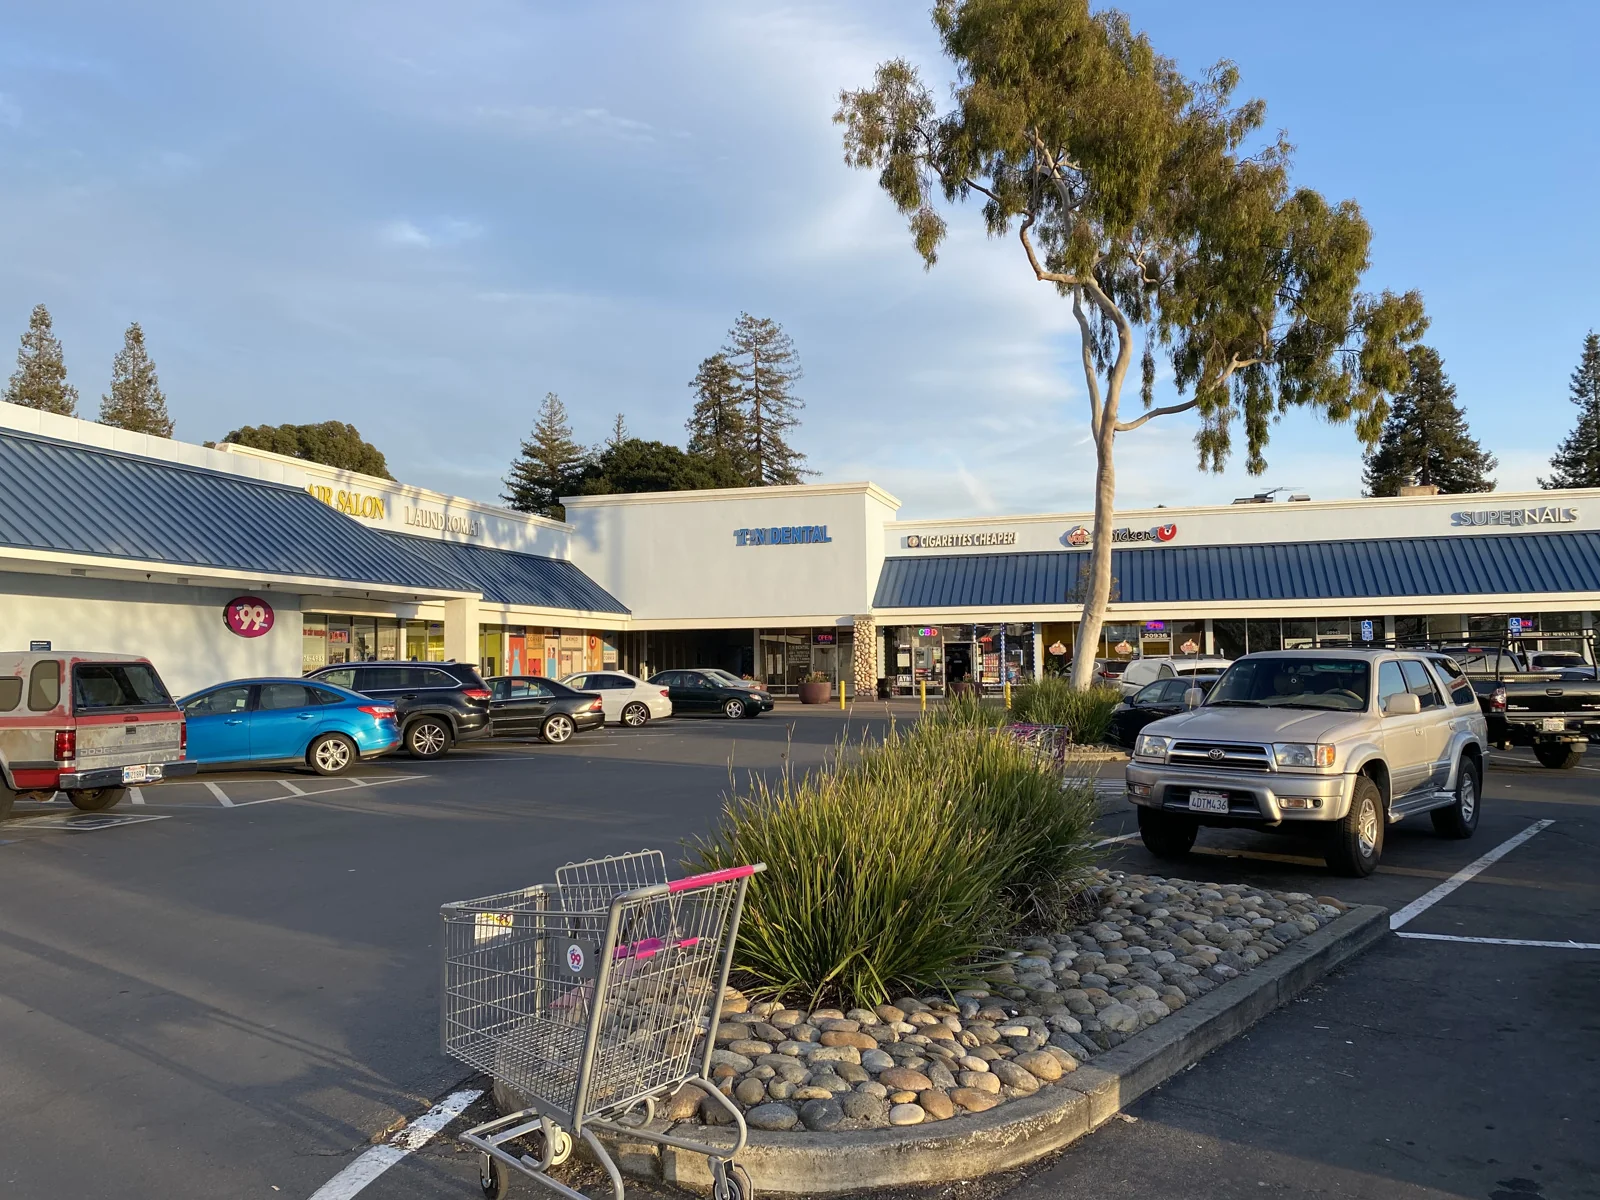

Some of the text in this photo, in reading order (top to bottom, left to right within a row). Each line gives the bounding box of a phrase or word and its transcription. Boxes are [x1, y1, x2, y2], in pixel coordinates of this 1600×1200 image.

[337, 489, 385, 520] SALON
[404, 505, 481, 537] LAUNDROMAT
[769, 525, 832, 545] DENTAL
[920, 531, 1020, 547] CIGARETTES CHEAPER!
[239, 604, 265, 630] 99
[918, 628, 938, 637] CBD
[1191, 797, 1227, 811] 4DTM436
[570, 953, 582, 966] 99
